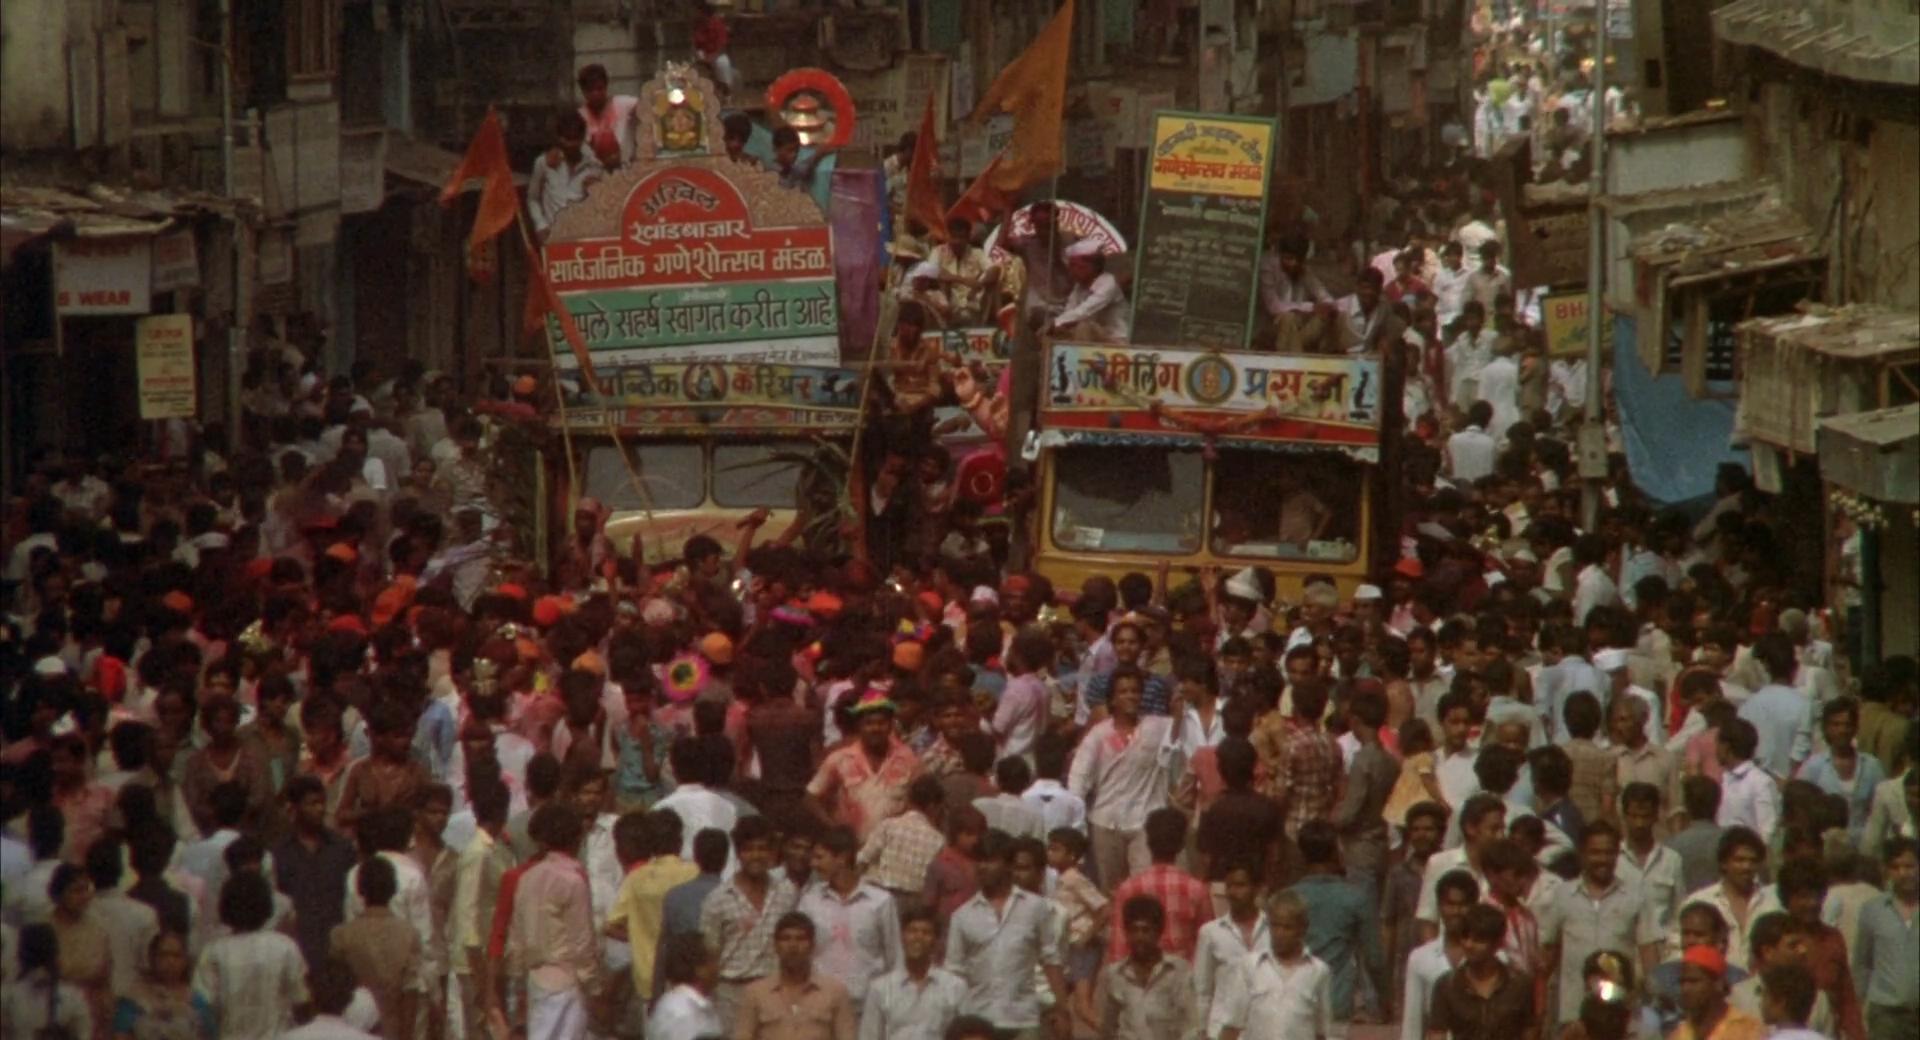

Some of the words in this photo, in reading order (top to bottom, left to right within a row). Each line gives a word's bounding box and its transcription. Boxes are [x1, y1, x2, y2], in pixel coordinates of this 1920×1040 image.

[549, 246, 647, 283] सार्वजनिक
[653, 241, 767, 281] गणेशोत्सव
[79, 290, 131, 306] WEAR
[616, 293, 661, 337] सहर्ष
[667, 302, 726, 334] स्वागत
[730, 288, 788, 331] करीत
[792, 286, 833, 327] आहे
